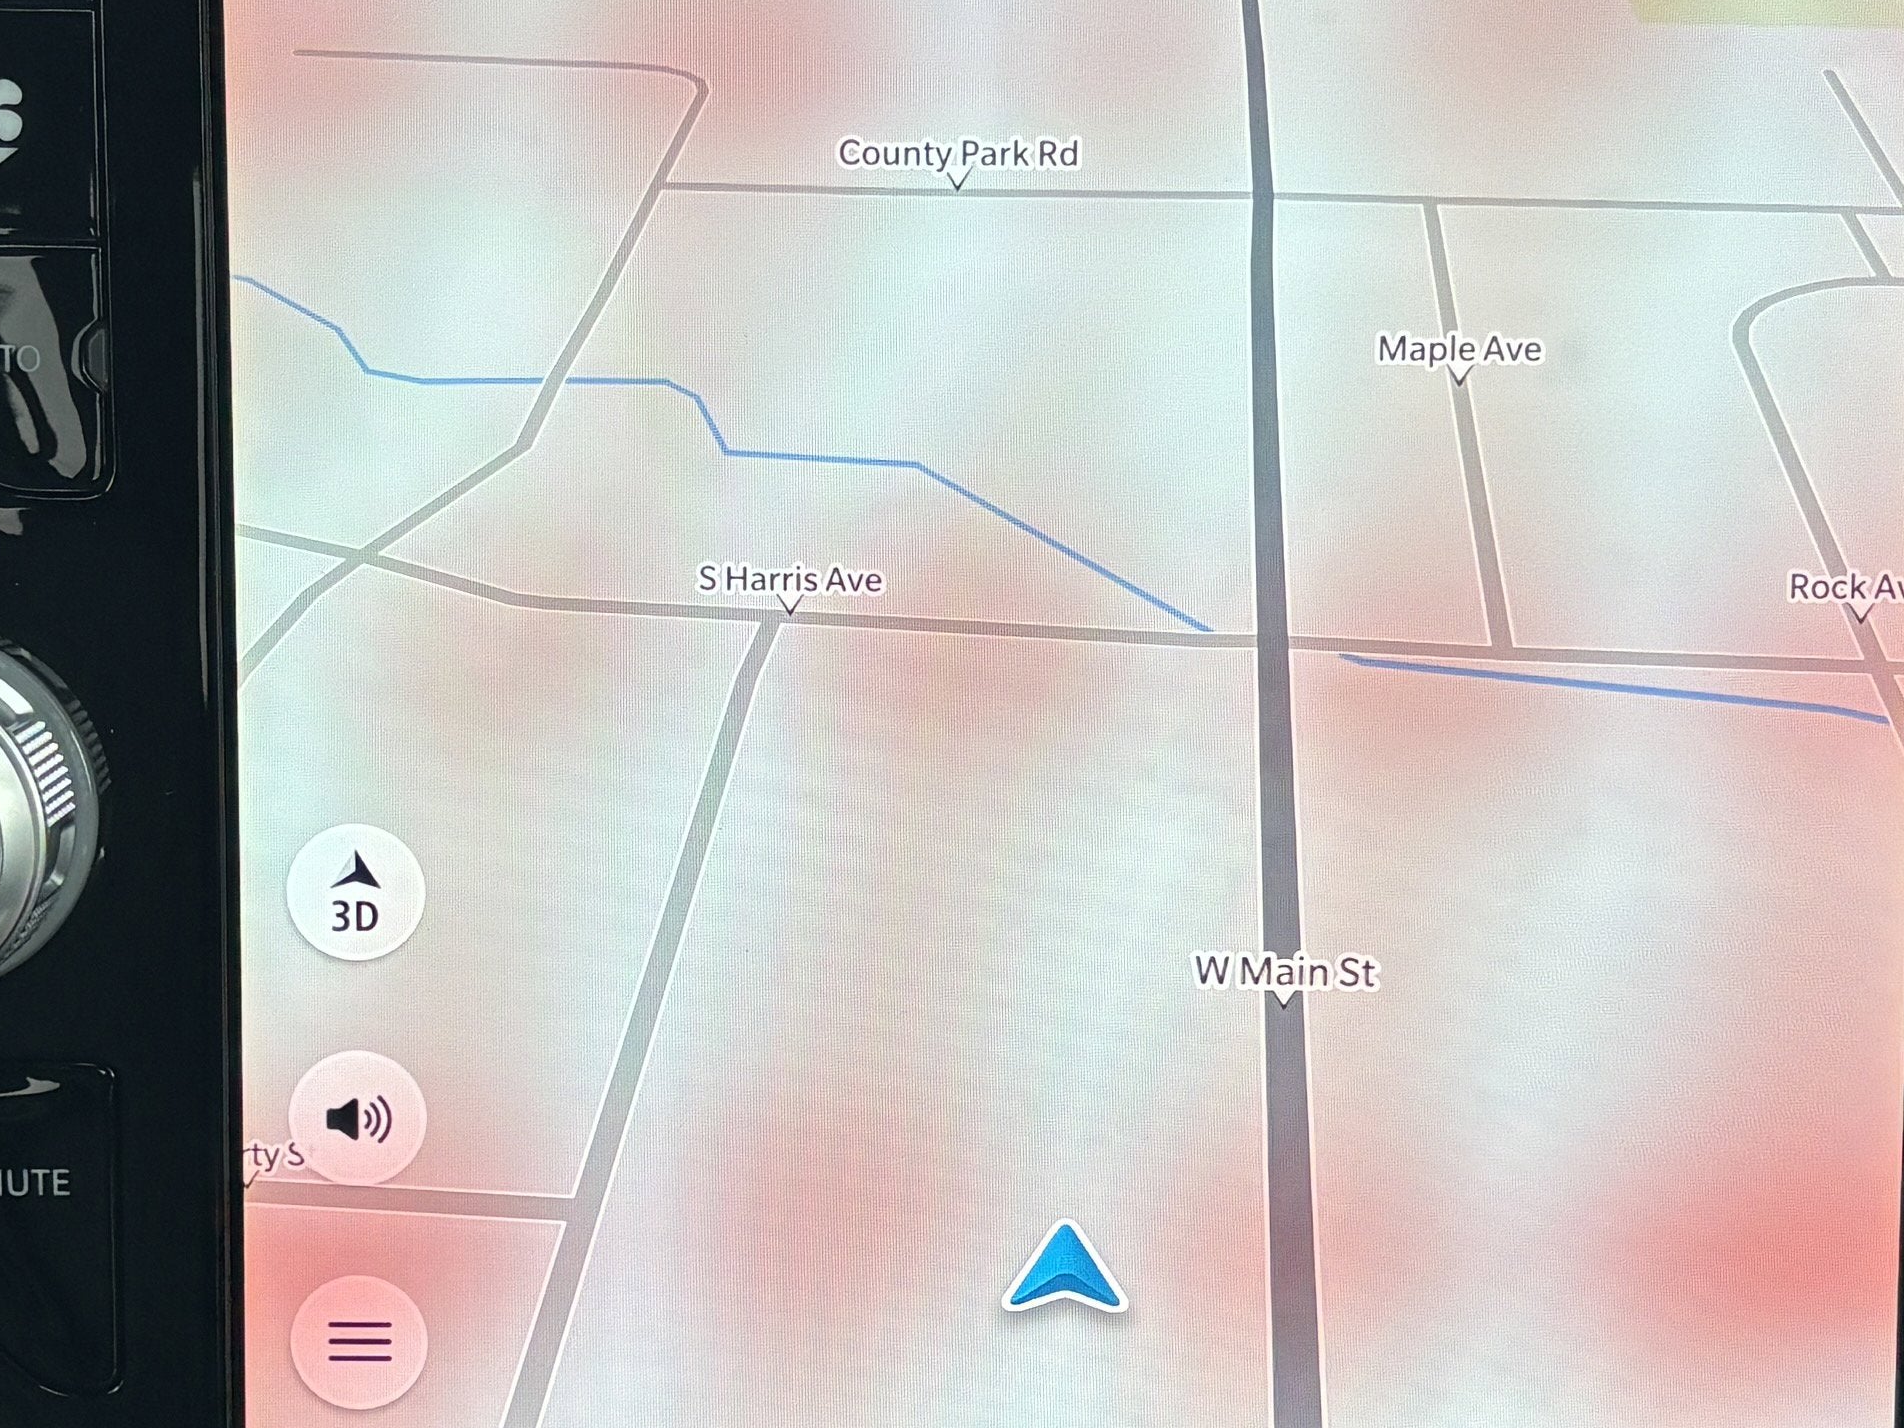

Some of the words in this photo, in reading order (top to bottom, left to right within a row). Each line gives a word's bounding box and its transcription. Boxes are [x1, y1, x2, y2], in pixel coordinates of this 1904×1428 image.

[839, 140, 952, 172] County
[961, 141, 1029, 167] Park
[1038, 141, 1079, 167] Rd
[1378, 336, 1477, 368] Maple
[1484, 336, 1542, 362] Ave
[700, 568, 717, 593] S
[725, 567, 819, 593] Harris
[826, 568, 882, 593] Ave
[1791, 573, 1867, 600] Rock
[332, 901, 379, 933] 3D
[1196, 956, 1229, 984] W
[1240, 956, 1330, 987] Main
[1339, 957, 1376, 987] St
